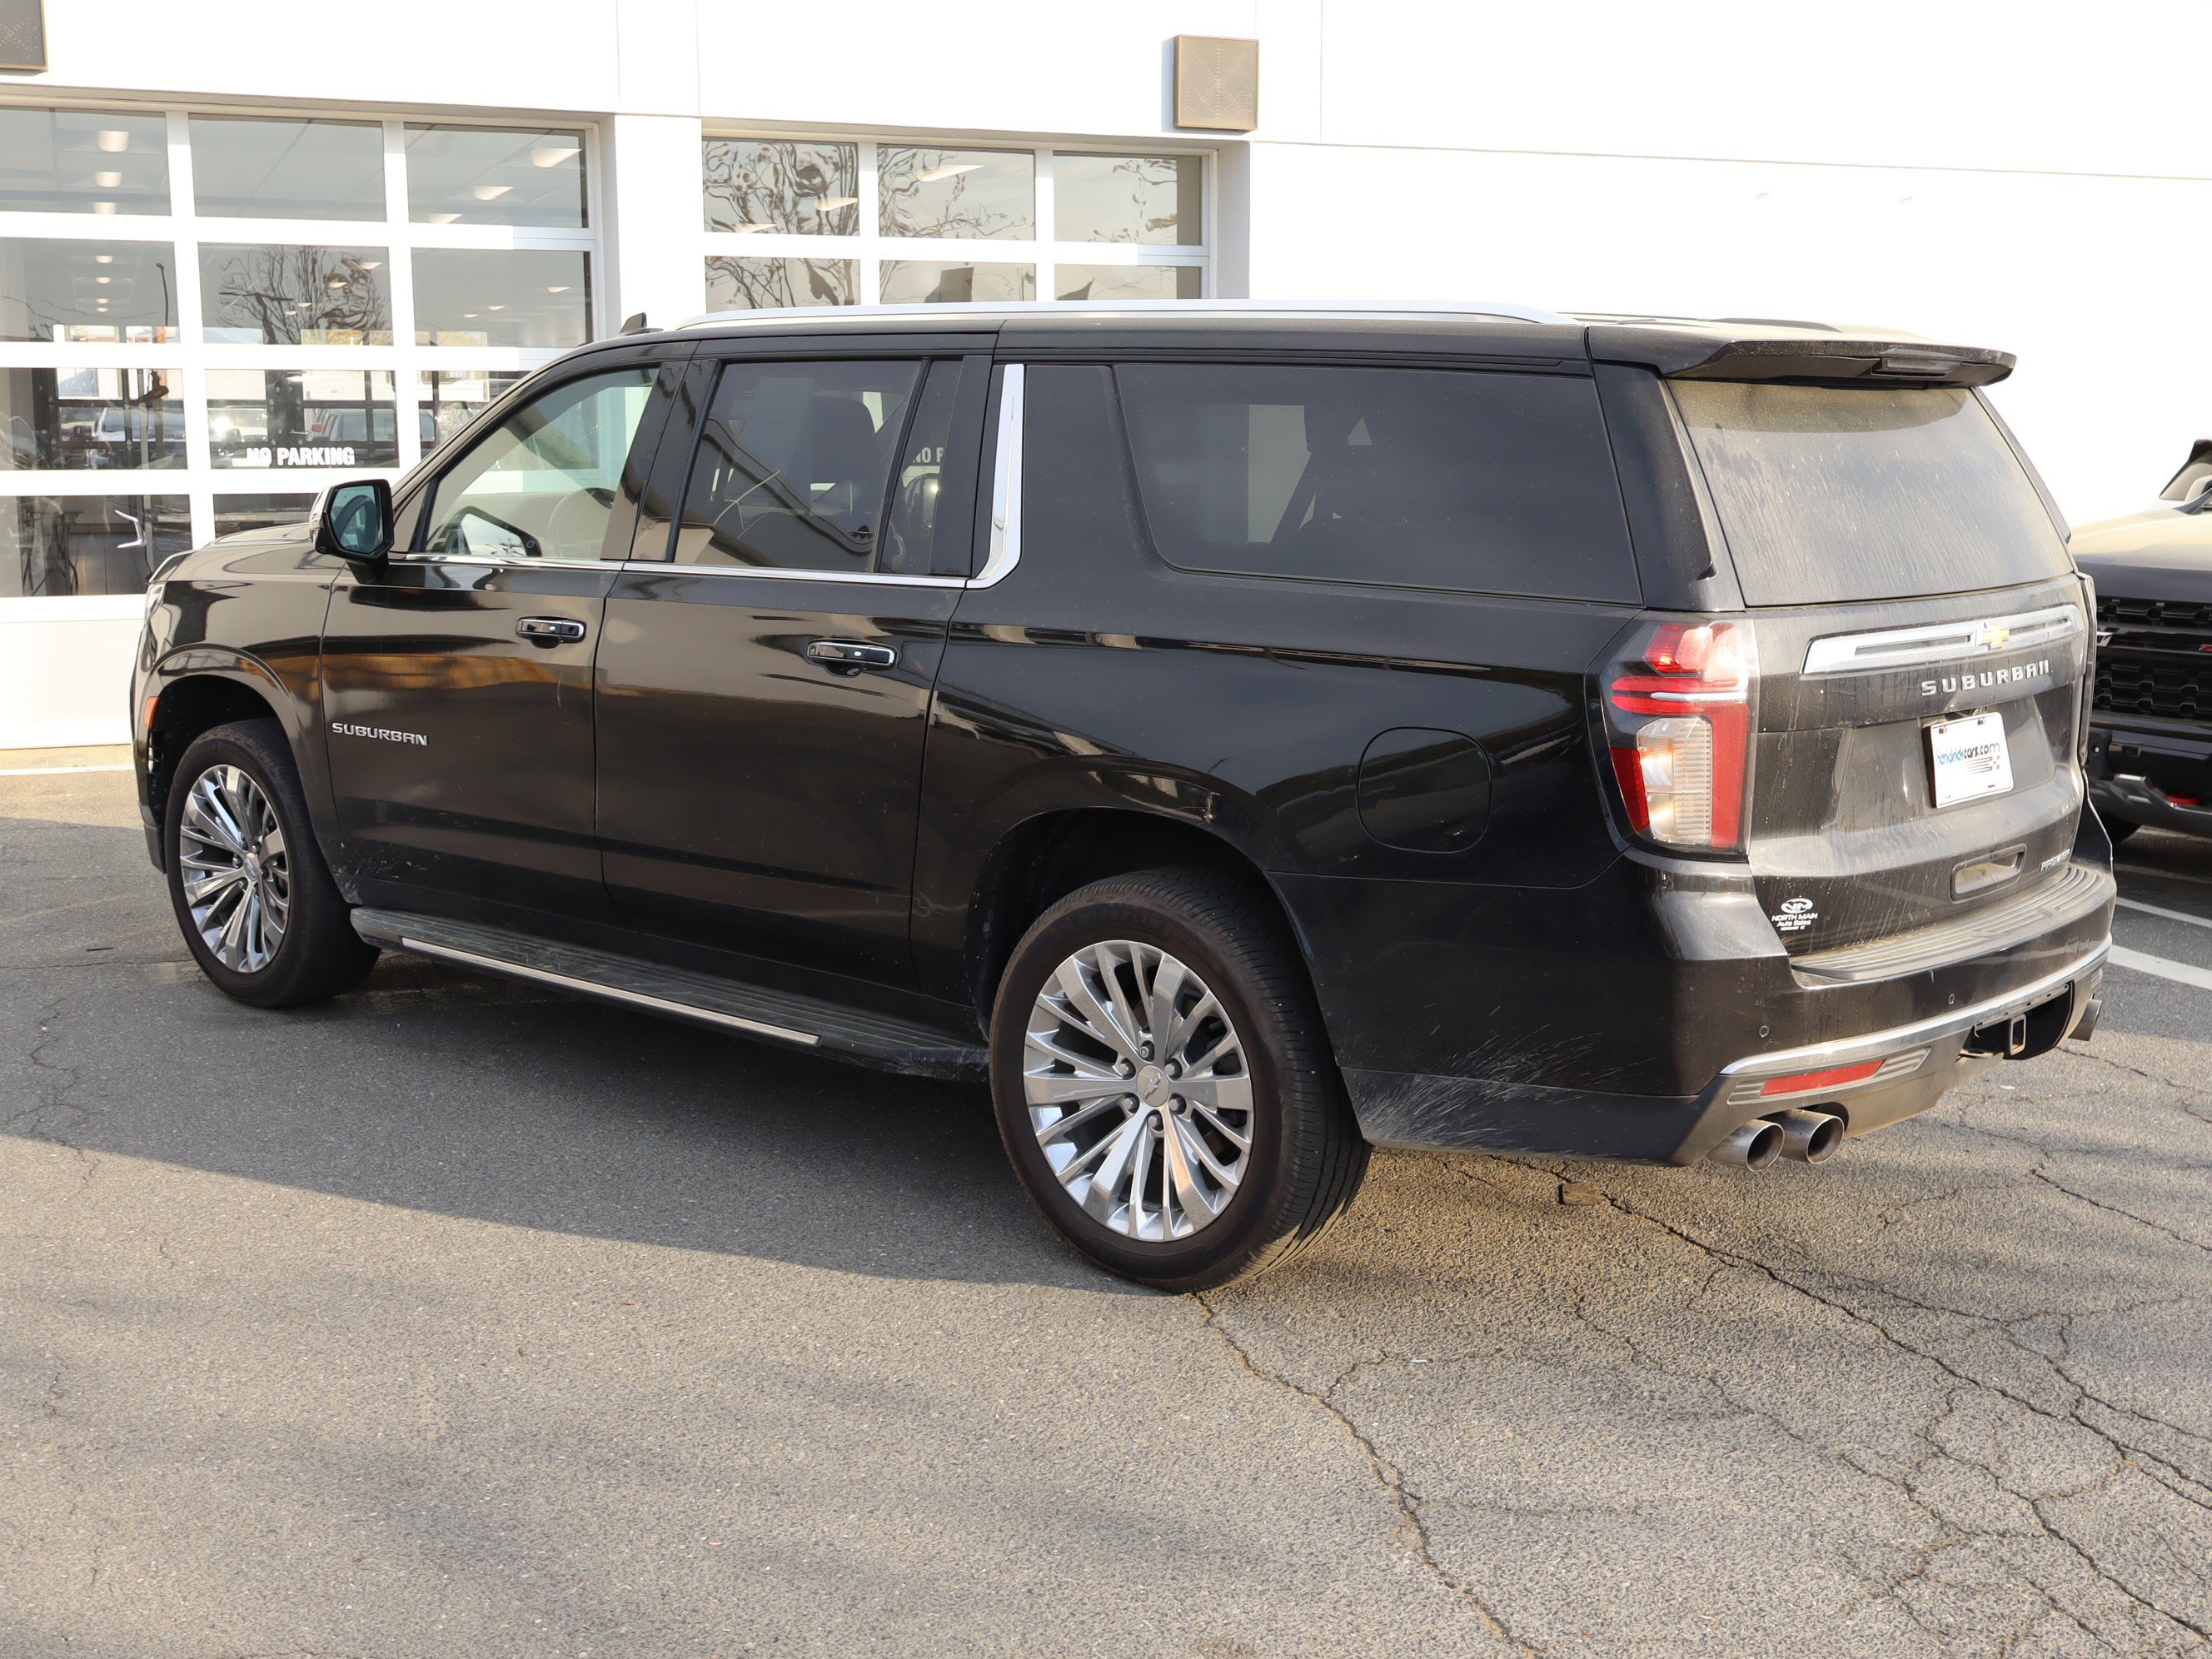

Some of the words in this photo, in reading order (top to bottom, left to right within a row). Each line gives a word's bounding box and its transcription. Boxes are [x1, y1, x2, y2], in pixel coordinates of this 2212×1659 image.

[276, 447, 356, 466] PARKING
[1921, 660, 2050, 697] SUBURBAN
[331, 722, 429, 746] SUBURBAN
[1771, 914, 1798, 922] NORTH
[1798, 912, 1818, 920] MAIN
